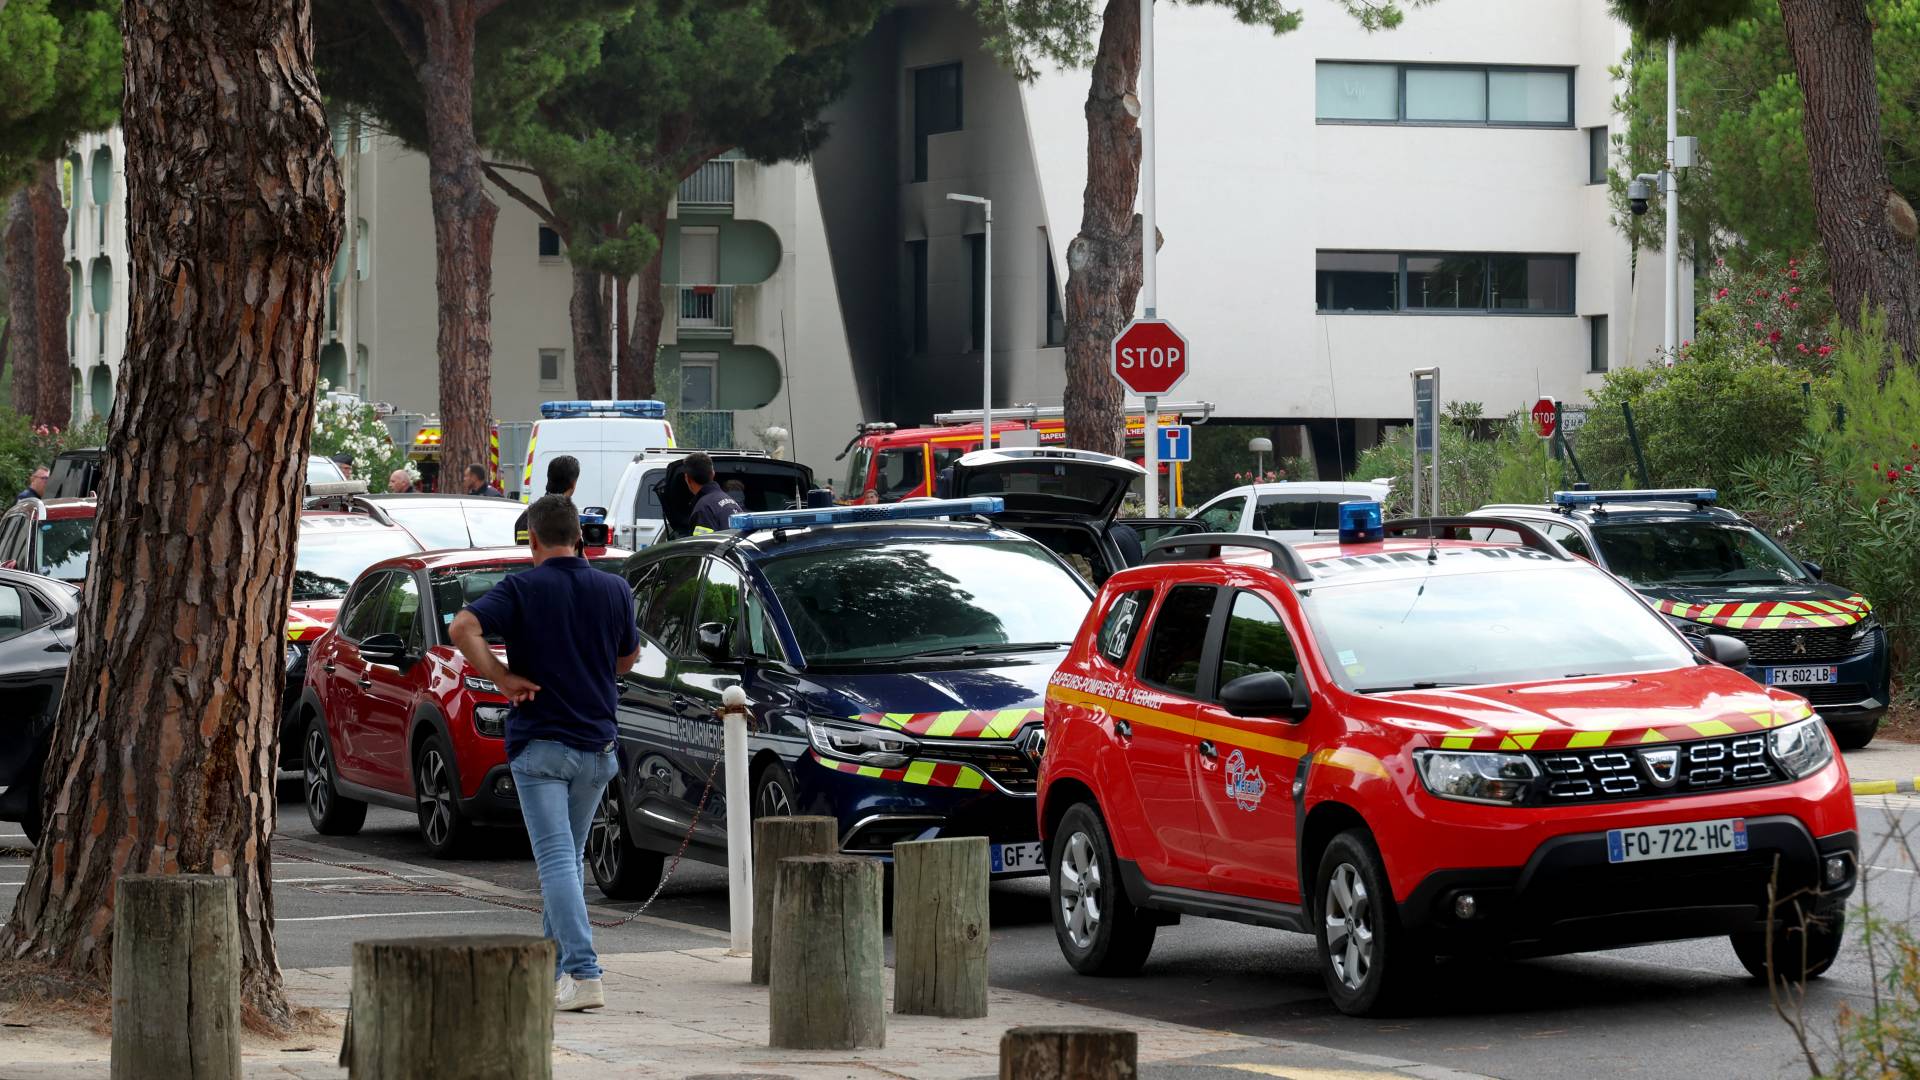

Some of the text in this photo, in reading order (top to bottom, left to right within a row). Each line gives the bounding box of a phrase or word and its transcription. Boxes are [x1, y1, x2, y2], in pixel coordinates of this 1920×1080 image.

[1121, 347, 1180, 369] STOP
[1534, 412, 1556, 424] STOP
[1113, 631, 1126, 655] 18
[1050, 670, 1117, 699] SAPEURS-POMPIERS
[1774, 668, 1829, 682] FX-602-LB
[677, 717, 725, 750] GENDARMERIE
[1624, 824, 1732, 857] FQ-722-HC
[1735, 835, 1746, 847] 34
